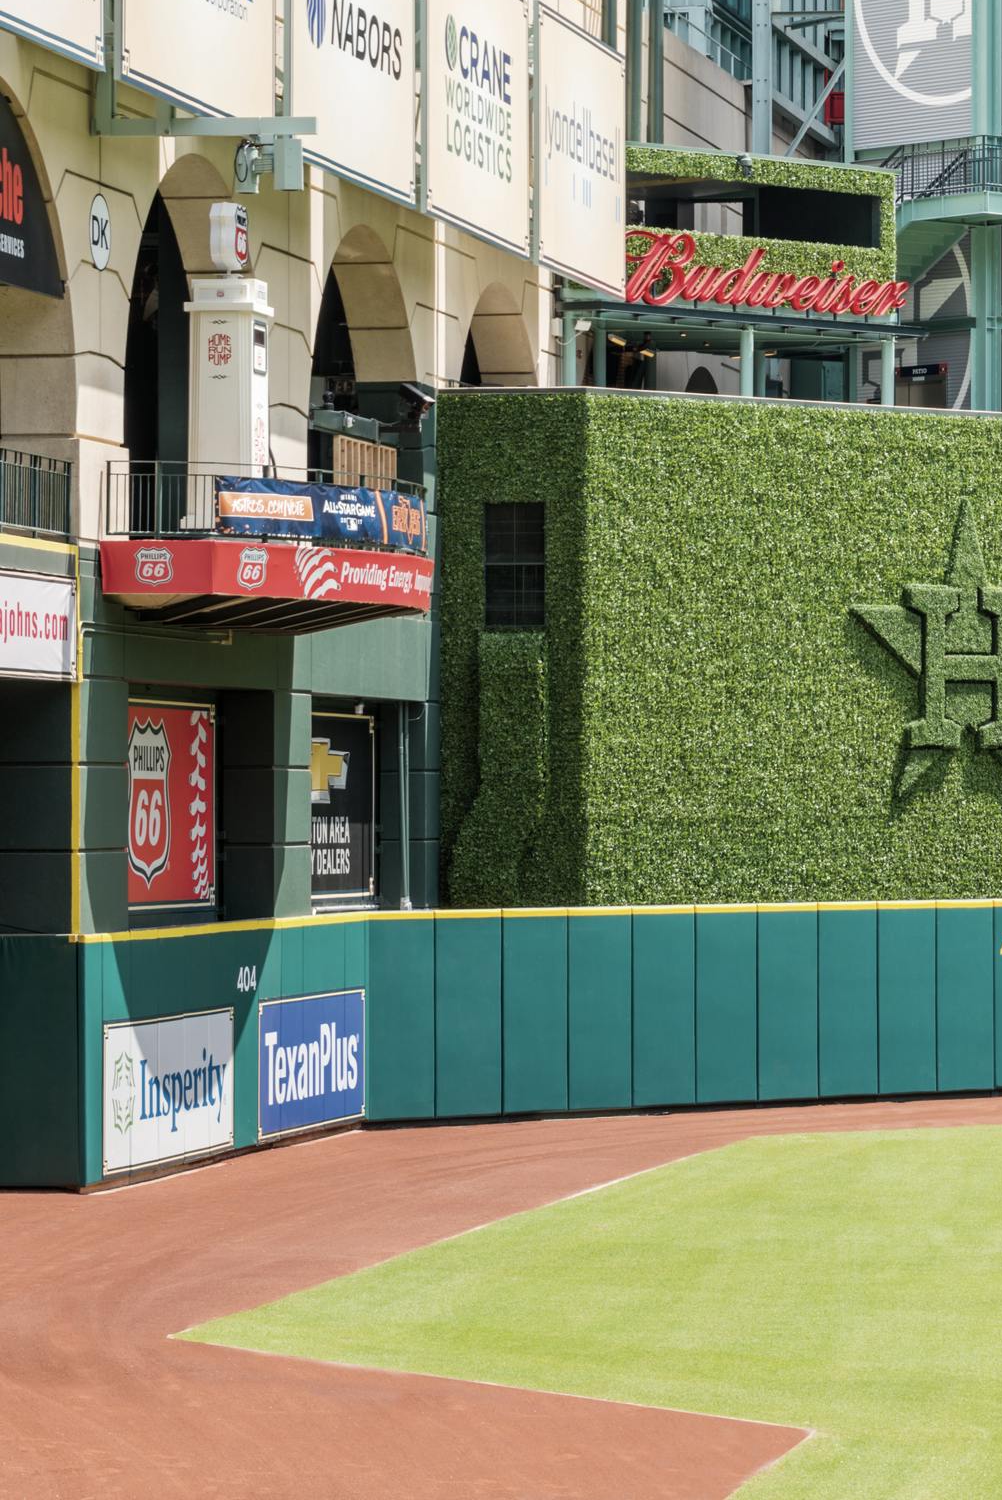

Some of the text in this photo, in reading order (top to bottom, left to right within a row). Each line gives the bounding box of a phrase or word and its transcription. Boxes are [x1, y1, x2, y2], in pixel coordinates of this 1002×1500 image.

[459, 25, 512, 105] CRANE
[445, 74, 512, 143] WORLDWIDE
[545, 84, 621, 184] lyondellbasell
[446, 114, 512, 184] LOGISTICS
[0, 148, 24, 225] he
[91, 215, 109, 250] DK
[625, 230, 909, 316] Budweiser
[208, 333, 231, 347] HOME
[208, 346, 232, 354] RUN
[208, 353, 232, 366] PUMP
[140, 552, 168, 561] PHILLIPS
[142, 563, 165, 577] 66
[243, 552, 265, 562] PHILLIPS
[242, 564, 262, 580] 66
[340, 561, 388, 591] Providing
[134, 745, 165, 773] PHILLIPS
[135, 789, 163, 847] 66
[330, 817, 350, 844] AREA
[317, 848, 350, 876] DEALERS
[237, 965, 257, 993] 404
[265, 1022, 358, 1106] TexanPlus
[139, 1047, 227, 1132] Insperity
